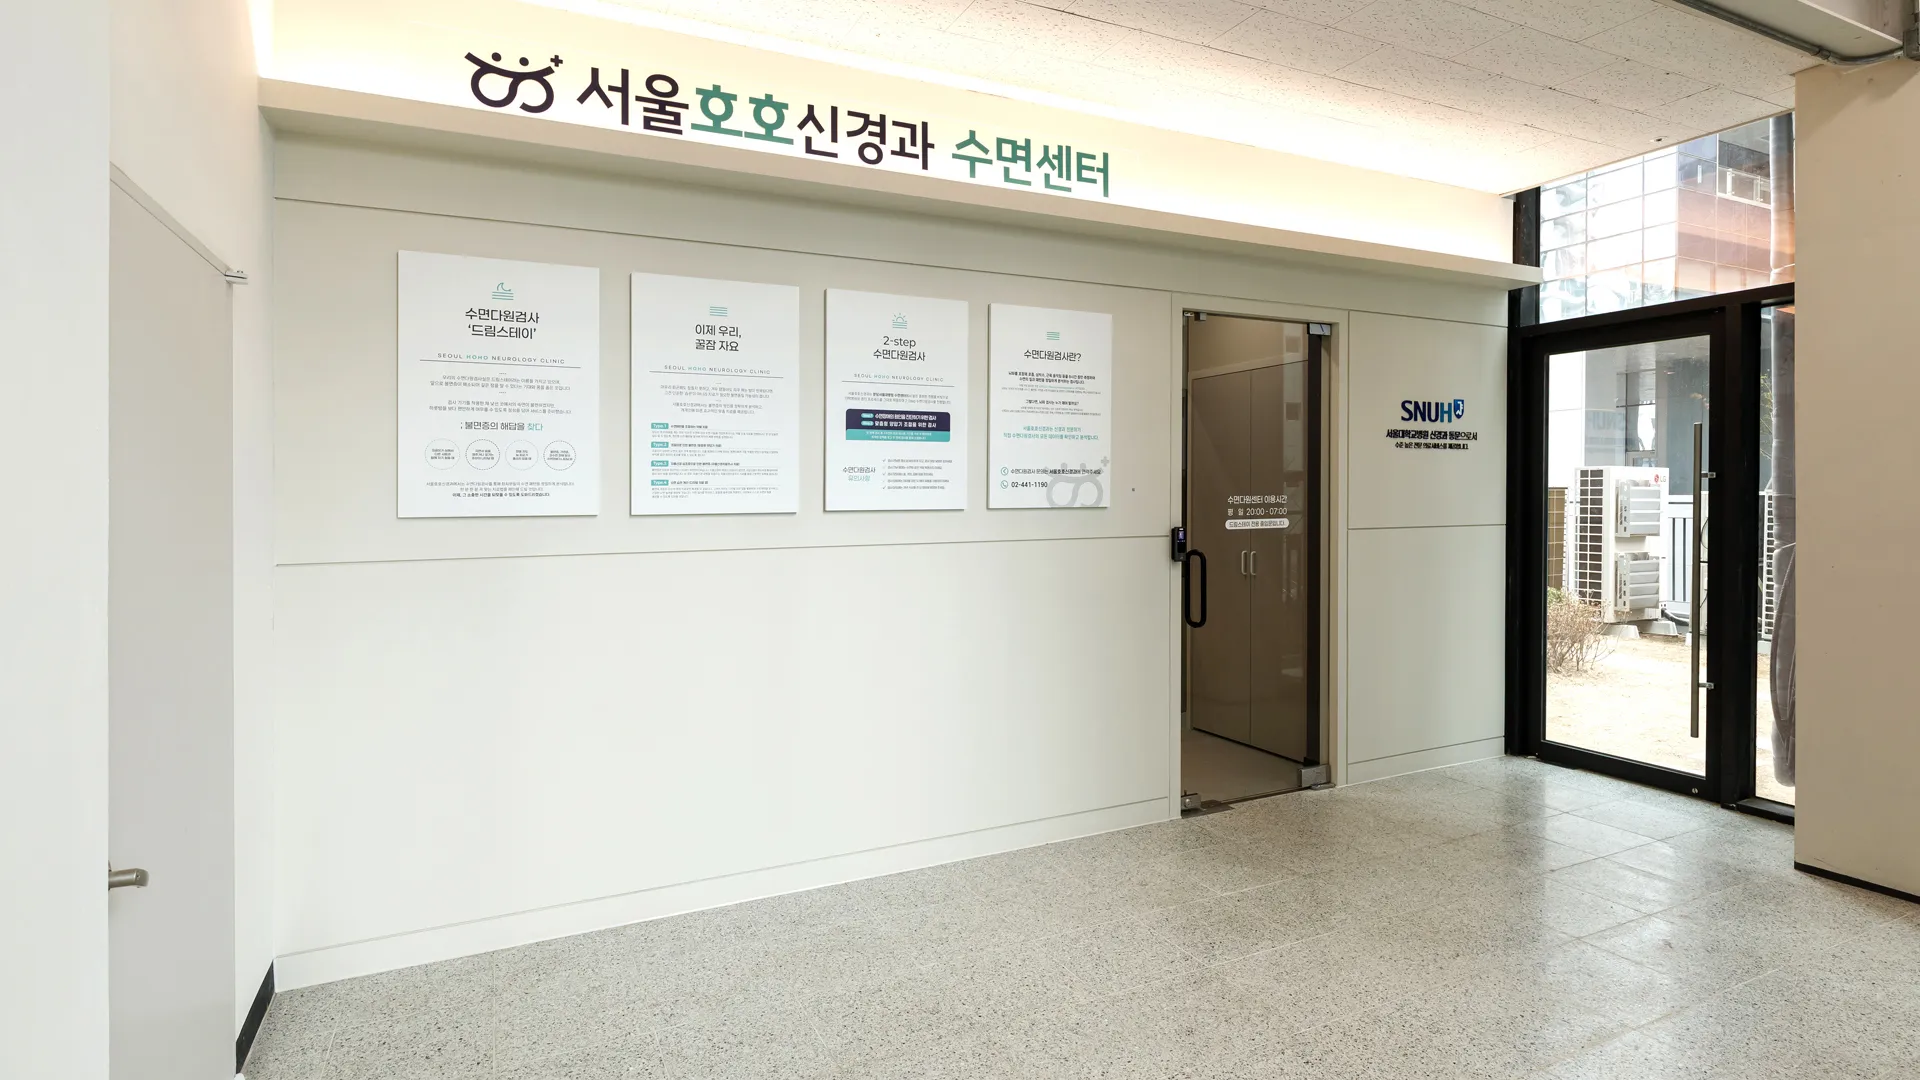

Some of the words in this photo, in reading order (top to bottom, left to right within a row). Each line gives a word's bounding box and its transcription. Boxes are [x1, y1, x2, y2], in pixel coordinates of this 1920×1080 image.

[576, 66, 935, 170] 서울호호신경과
[952, 129, 1109, 198] 수면센터
[465, 308, 540, 324] 수면다원검사
[695, 324, 716, 336] 이제
[718, 326, 742, 338] 우리,
[695, 338, 716, 351] 꿀잠
[718, 340, 739, 352] 자요
[883, 336, 916, 348] 2-step
[873, 348, 926, 361] 수면다원검사
[1024, 349, 1082, 362] 수면다원검사란?
[1401, 400, 1452, 423] SNUH
[465, 421, 499, 430] 불면증의
[500, 422, 525, 431] 해답을
[527, 422, 544, 431] 찾다
[1386, 429, 1429, 440] 서울대학교병원
[1430, 430, 1448, 440] 신경과
[1228, 496, 1264, 504] 수면다원센터
[1264, 495, 1287, 504] 이용시간
